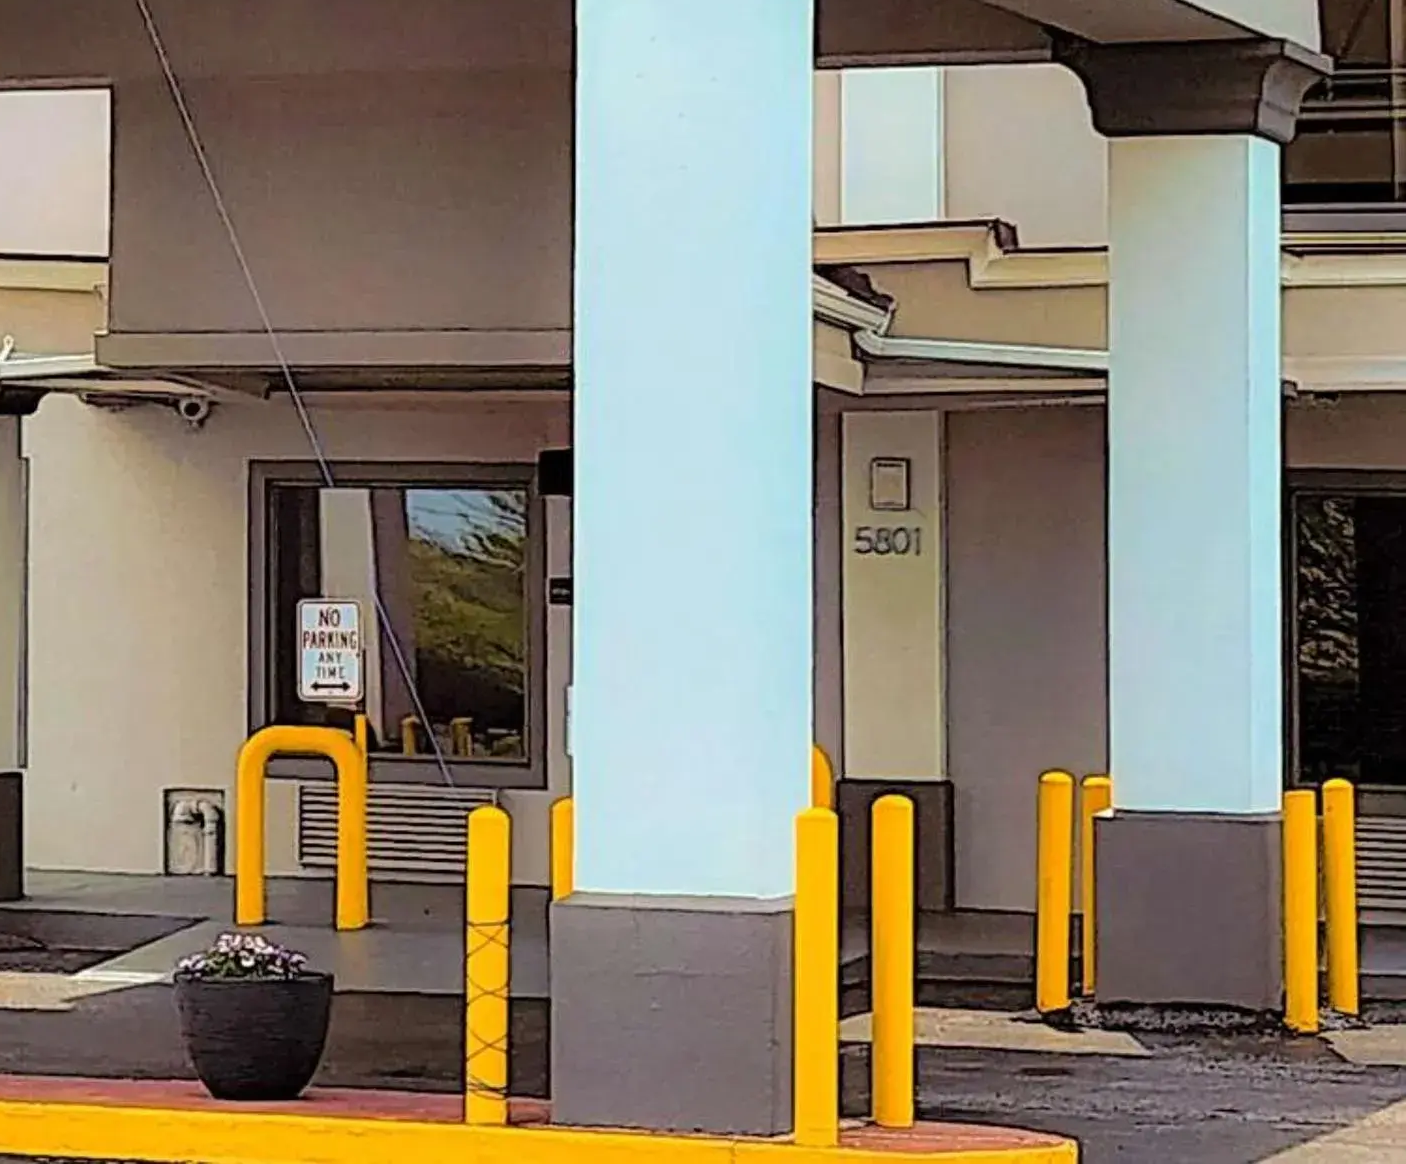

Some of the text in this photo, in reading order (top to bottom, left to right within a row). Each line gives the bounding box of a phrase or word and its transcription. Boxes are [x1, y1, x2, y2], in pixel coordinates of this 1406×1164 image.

[854, 526, 922, 556] 5801
[318, 608, 341, 627] NO
[303, 631, 357, 650] PARKING
[318, 652, 342, 664] ANY
[316, 666, 345, 679] TIME
